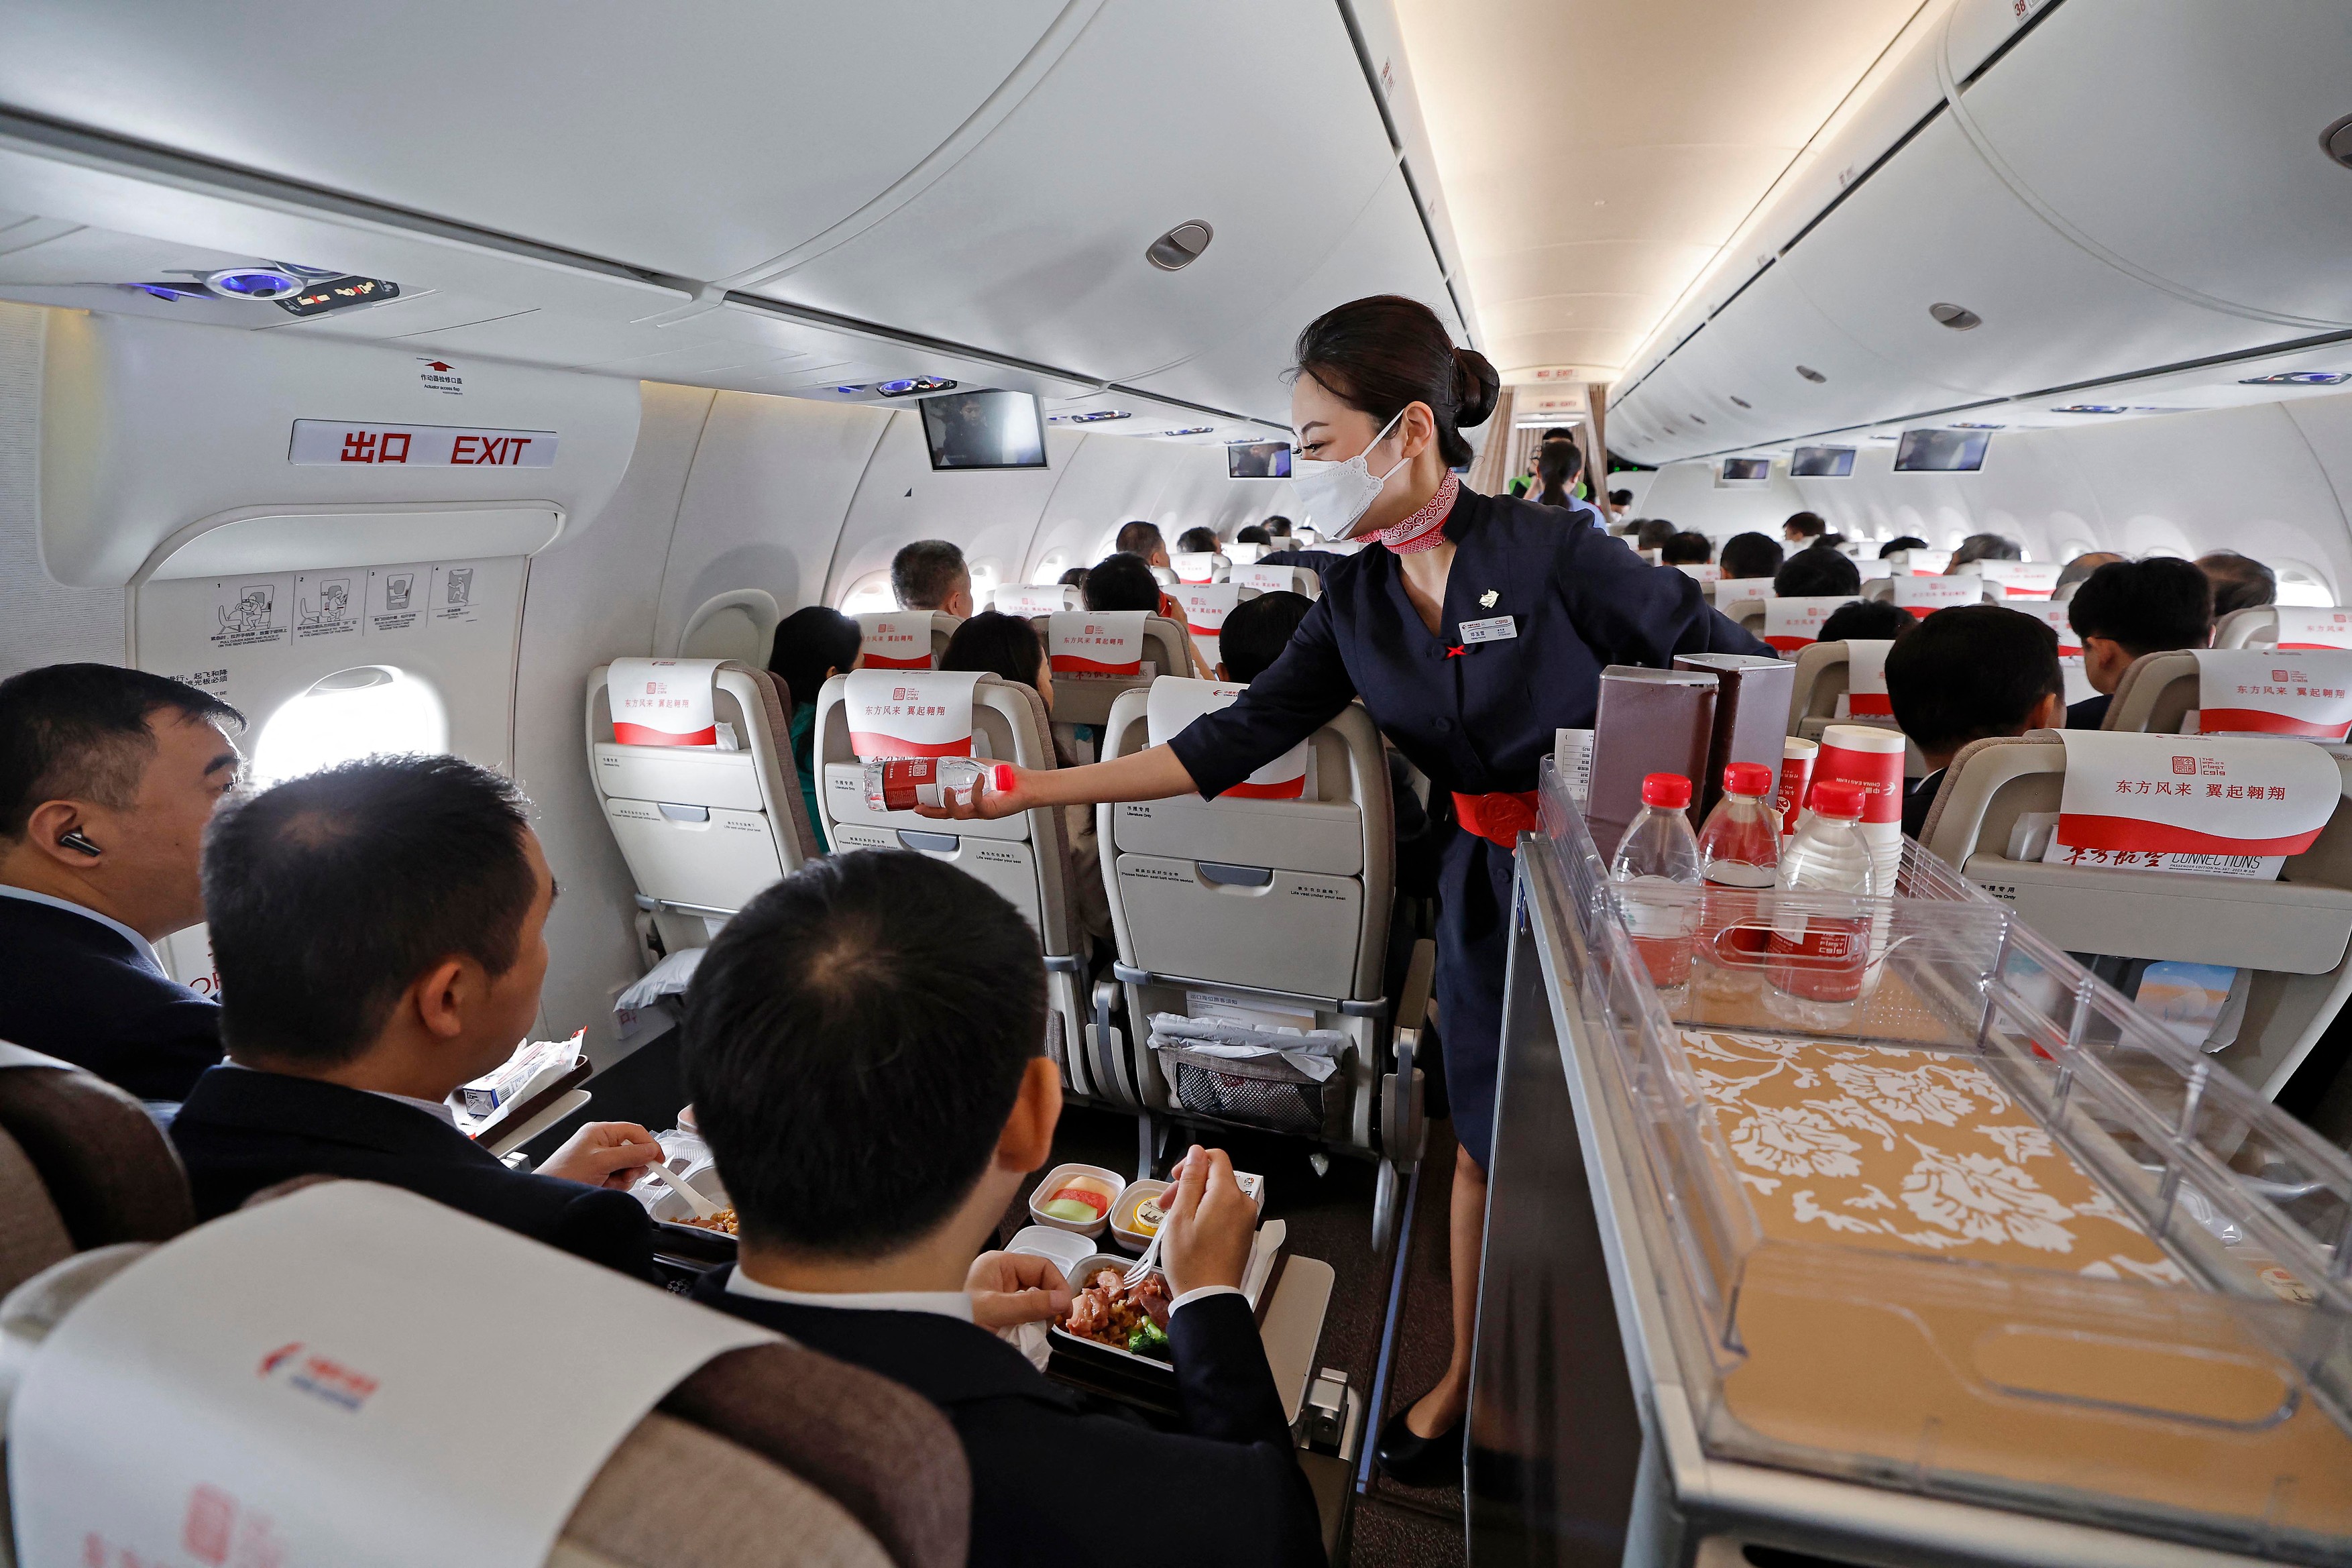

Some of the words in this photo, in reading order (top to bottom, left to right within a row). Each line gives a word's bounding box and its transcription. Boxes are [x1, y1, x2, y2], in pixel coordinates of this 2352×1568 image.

[2015, 0, 2025, 16] 38
[421, 374, 462, 384] 作动器检修口盖
[341, 431, 412, 463] 出口
[450, 436, 532, 465] EXIT
[2237, 685, 2288, 695] 东方风来
[2296, 687, 2345, 698] 翼起翱翔
[625, 699, 653, 708] 东方风来
[658, 699, 689, 708] 翼起翱翔
[864, 706, 901, 716] 东方风来
[907, 706, 946, 716] 翼起翱翔
[1836, 777, 1862, 786] EASTERN
[2115, 780, 2192, 796] 东方风来
[2206, 784, 2286, 801] 翼起翱翔
[2171, 853, 2263, 869] CONNECTIONS
[1819, 946, 1843, 954] C919
[1190, 993, 1238, 1005] 出口座位旅客须知
